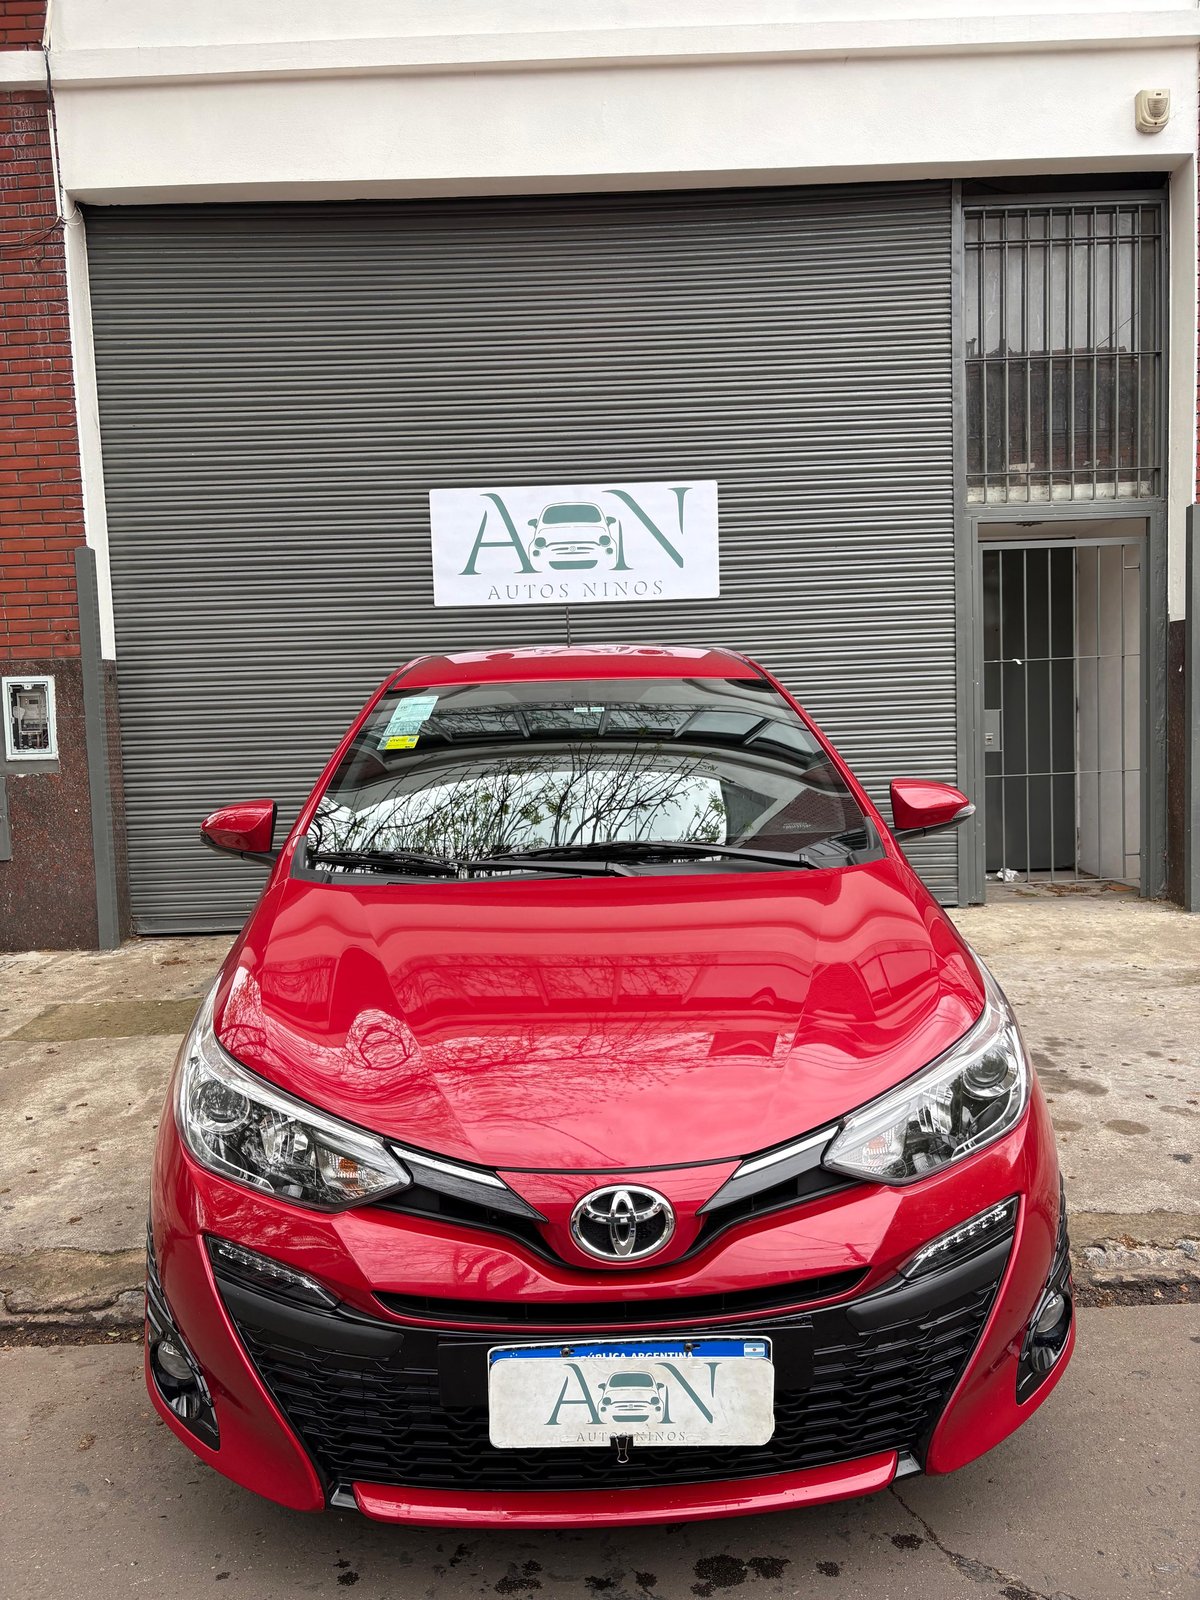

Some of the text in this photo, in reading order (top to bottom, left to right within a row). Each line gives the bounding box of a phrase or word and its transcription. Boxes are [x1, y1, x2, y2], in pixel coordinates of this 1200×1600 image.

[487, 580, 663, 600] AUTOS NINOS
[576, 1431, 628, 1442] AUT
